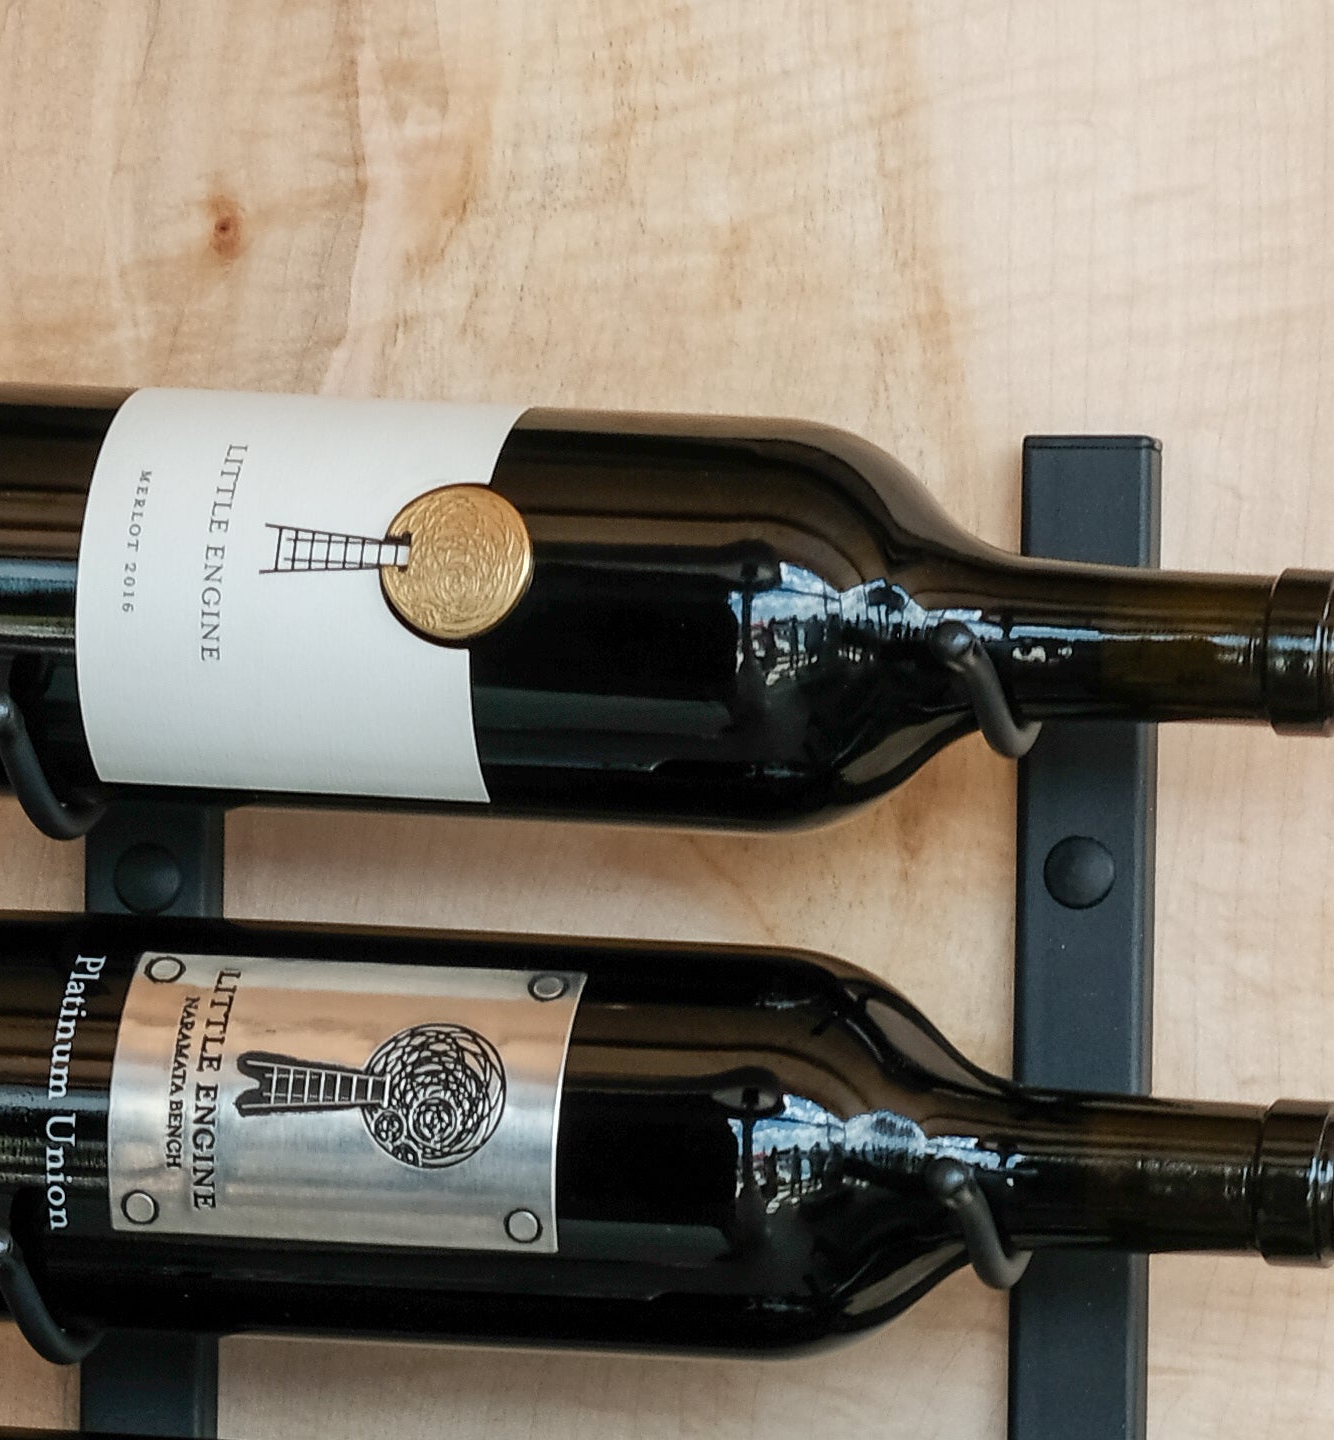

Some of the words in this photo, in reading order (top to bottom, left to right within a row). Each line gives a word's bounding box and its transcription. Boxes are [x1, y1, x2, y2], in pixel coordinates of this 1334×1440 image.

[129, 470, 153, 553] MERLOT
[208, 443, 248, 535] LITTLE
[121, 562, 140, 613] 2016
[200, 544, 226, 662] ENGINE
[48, 954, 107, 1100] Platinum
[169, 996, 200, 1096] NARAMATA
[196, 970, 241, 1072] LITTLE
[45, 1112, 76, 1230] Union
[166, 1100, 183, 1169] BENCH
[192, 1083, 218, 1210] ENGINE
